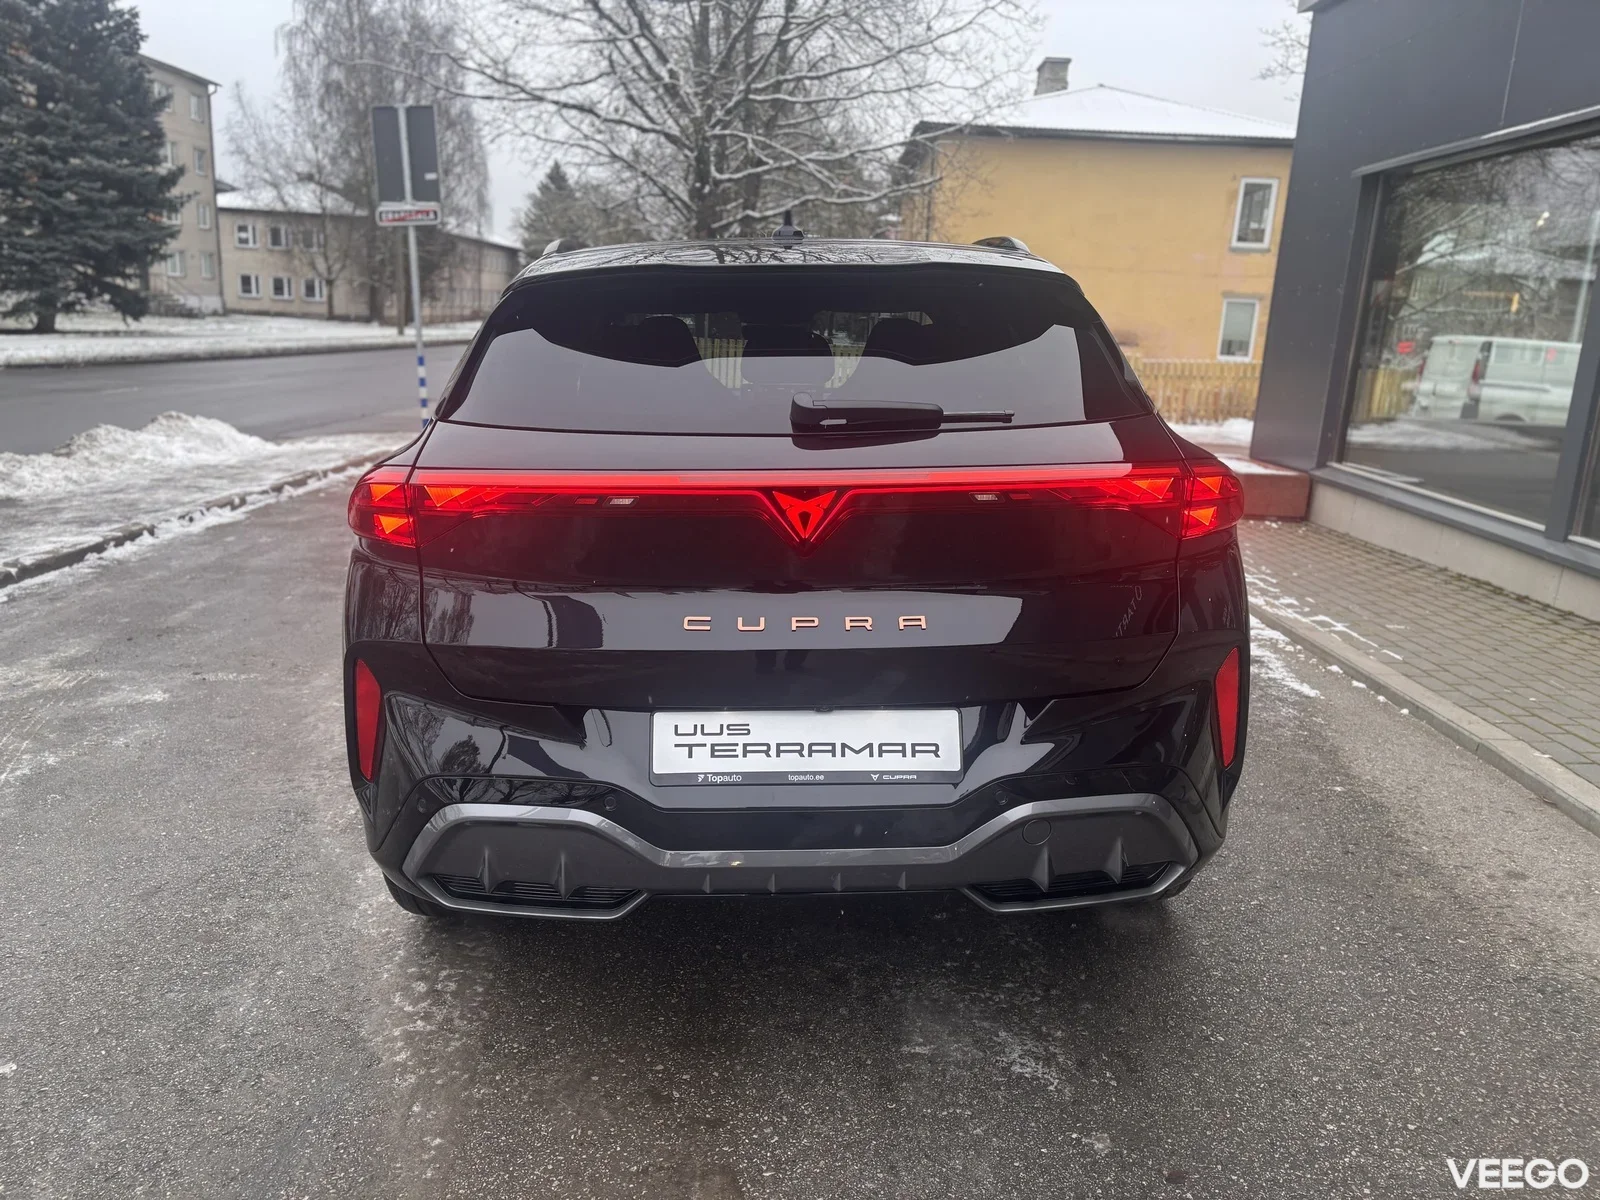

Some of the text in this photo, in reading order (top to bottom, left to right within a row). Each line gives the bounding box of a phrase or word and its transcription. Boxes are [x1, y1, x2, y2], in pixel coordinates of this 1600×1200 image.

[683, 615, 927, 631] CUPRA
[674, 723, 751, 736] UUS
[674, 742, 941, 759] TERRAMAR
[707, 774, 742, 783] Topauto
[788, 774, 825, 783] topauto.ee
